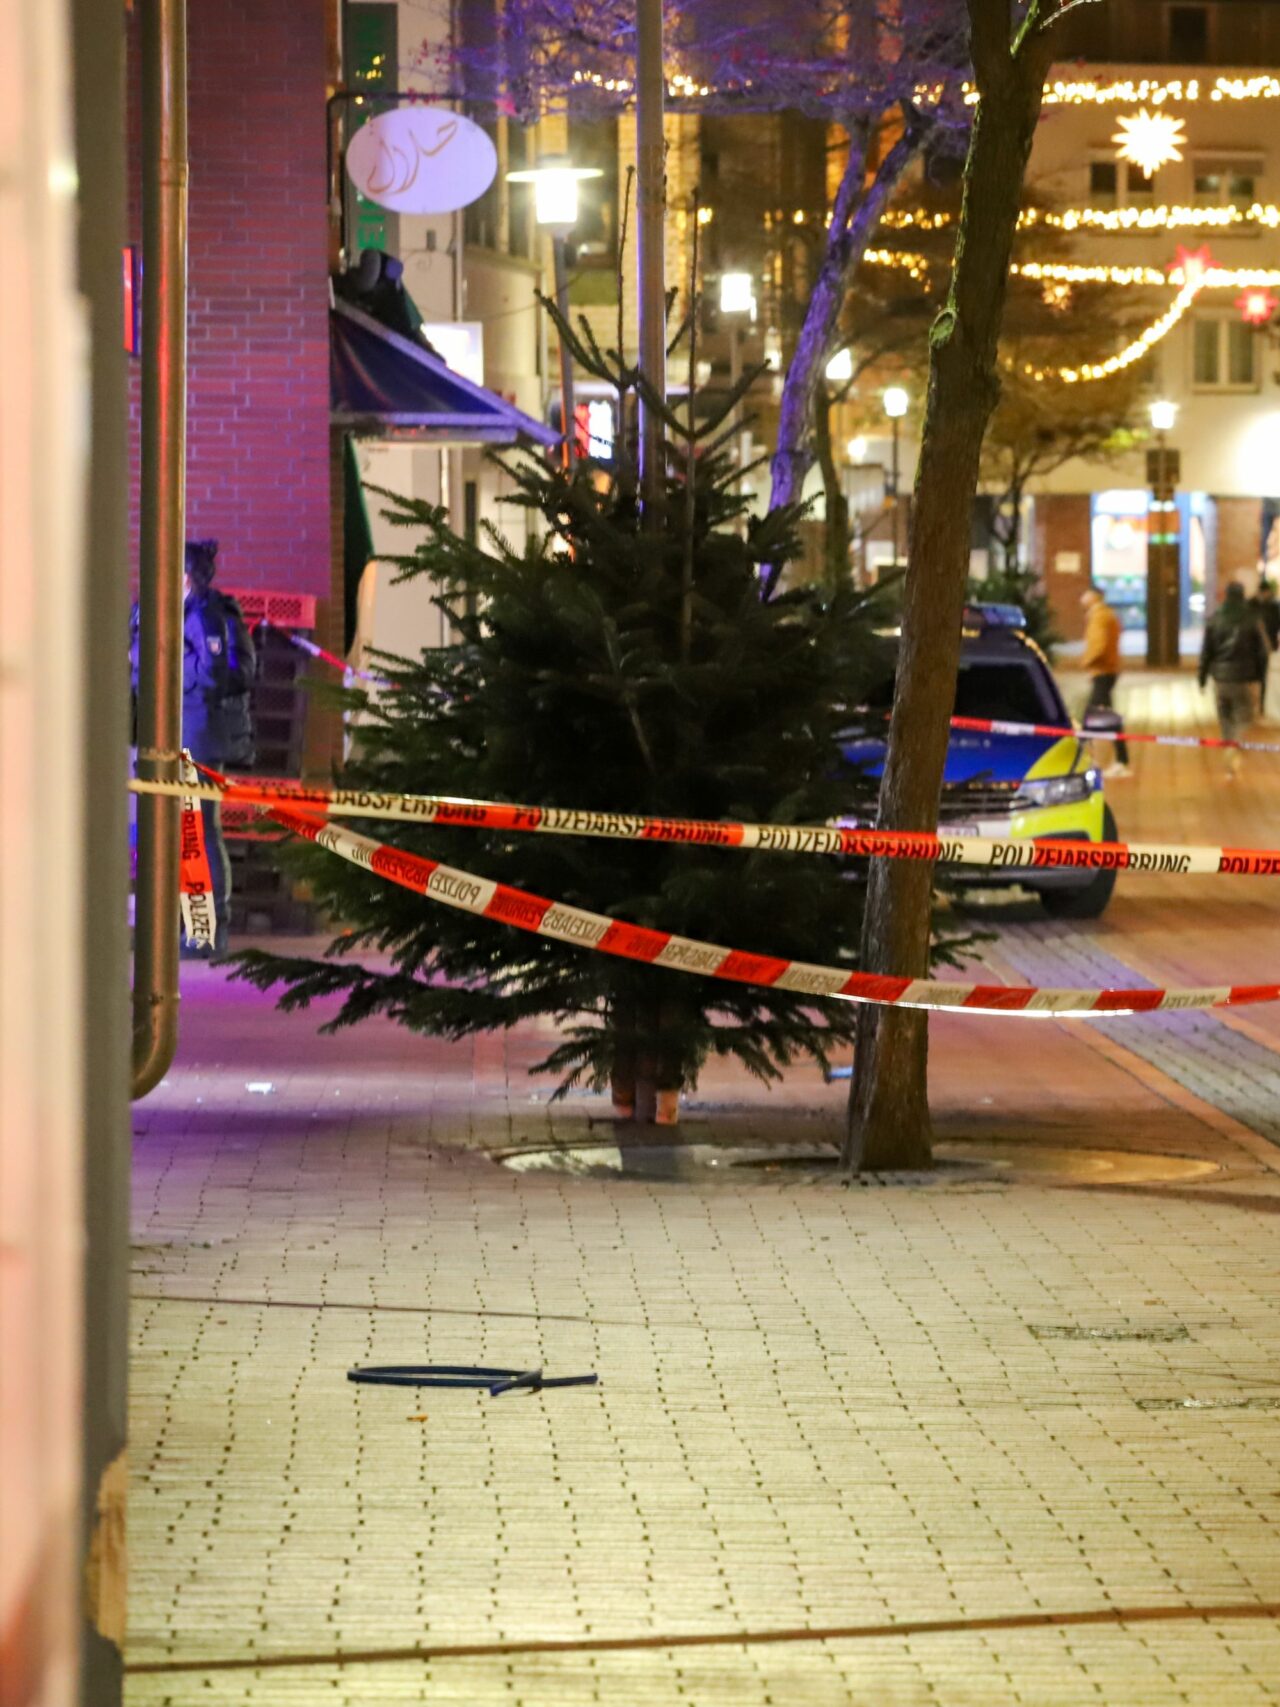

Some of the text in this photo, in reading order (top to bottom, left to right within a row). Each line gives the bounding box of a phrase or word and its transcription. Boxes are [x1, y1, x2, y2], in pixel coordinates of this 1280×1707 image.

[512, 806, 731, 845] POLIZEIABSPERRUNG
[756, 827, 964, 865] POLIZEIABSPERRUNG
[989, 841, 1191, 874] POLIZEIABSPERRUNG
